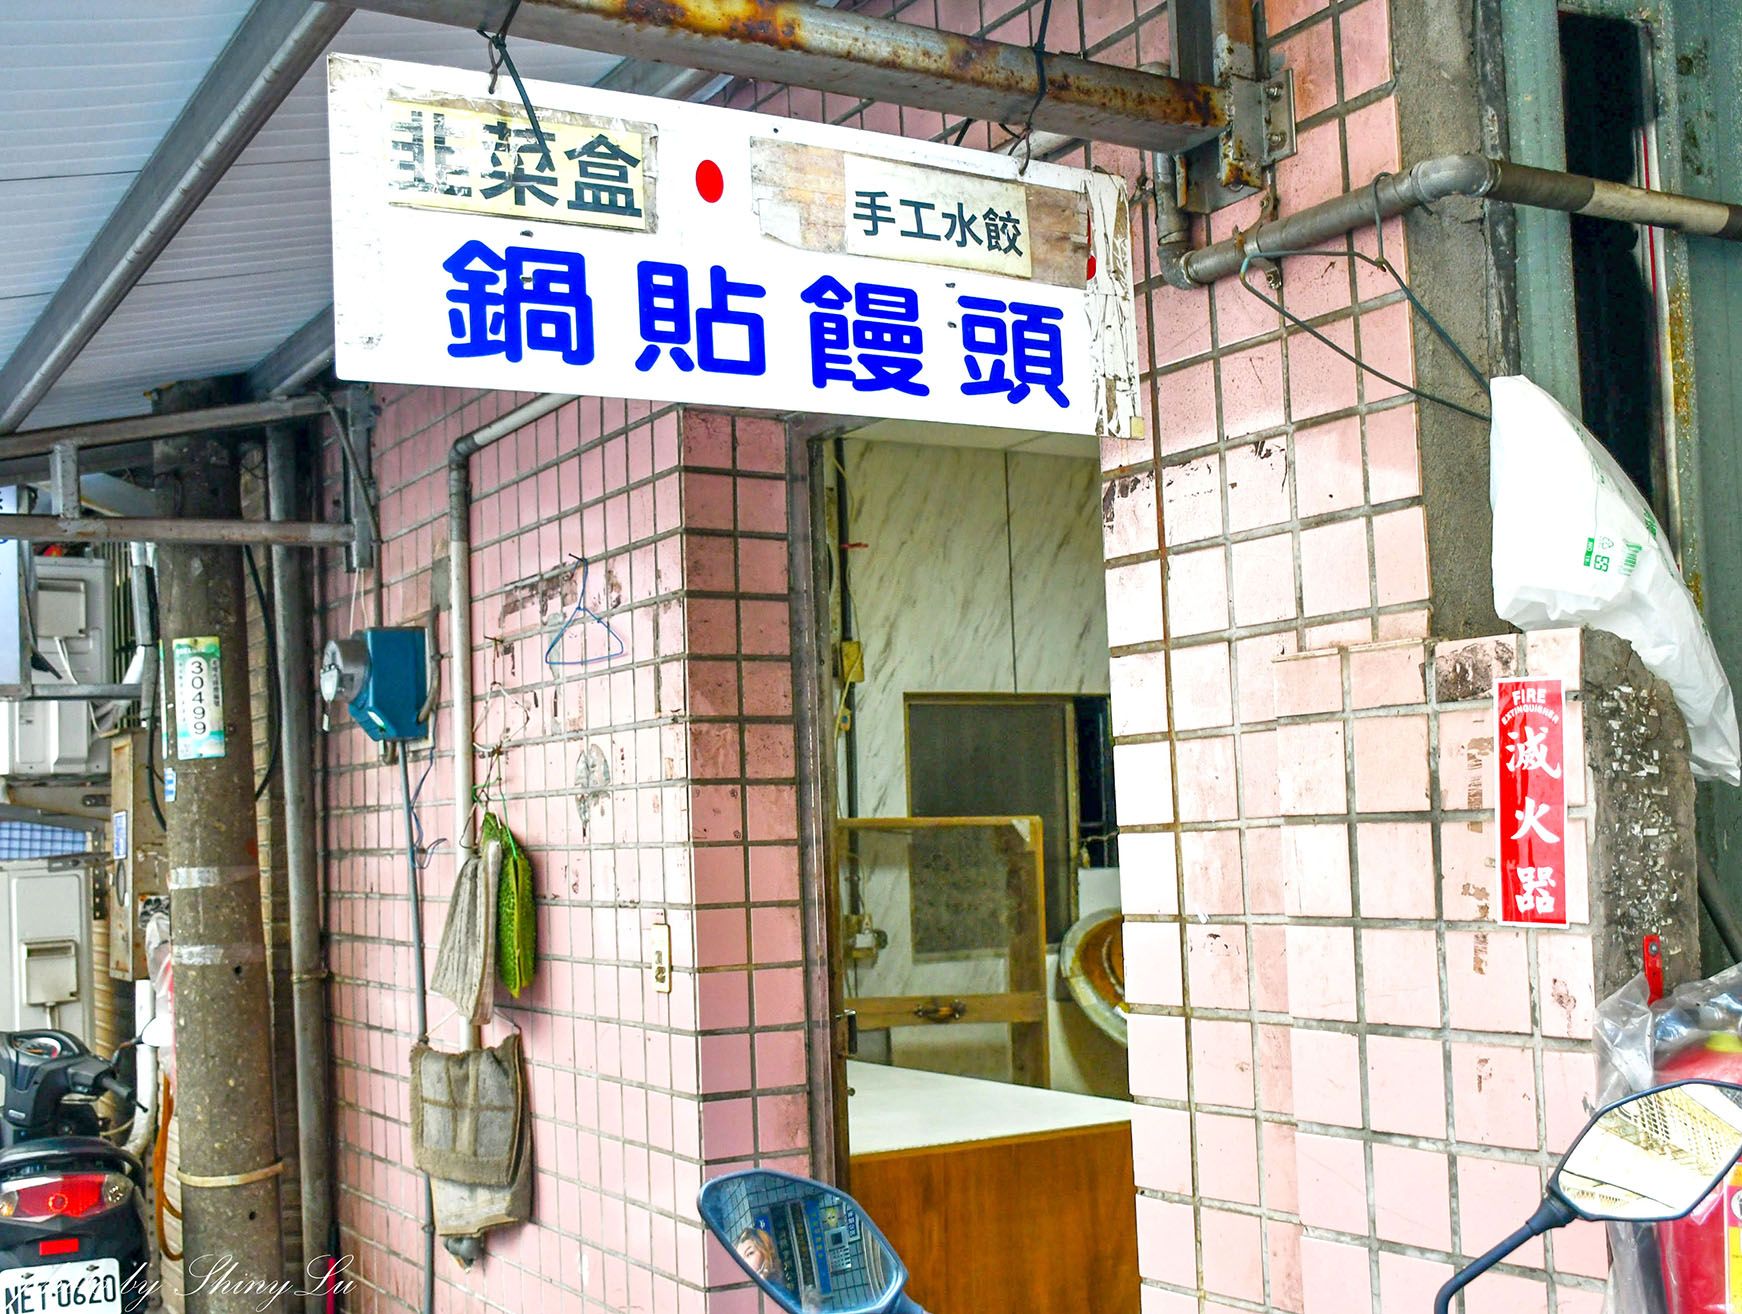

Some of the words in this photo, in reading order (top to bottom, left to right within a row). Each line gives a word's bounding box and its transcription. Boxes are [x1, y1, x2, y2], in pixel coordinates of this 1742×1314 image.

[853, 190, 1024, 258] 手工水餃
[442, 239, 1071, 408] 鍋貼饅頭
[191, 660, 206, 735] 30499
[1501, 703, 1559, 726] EXTINGUISHER
[1512, 687, 1546, 706] FIRE
[1505, 726, 1562, 914] 滅火器
